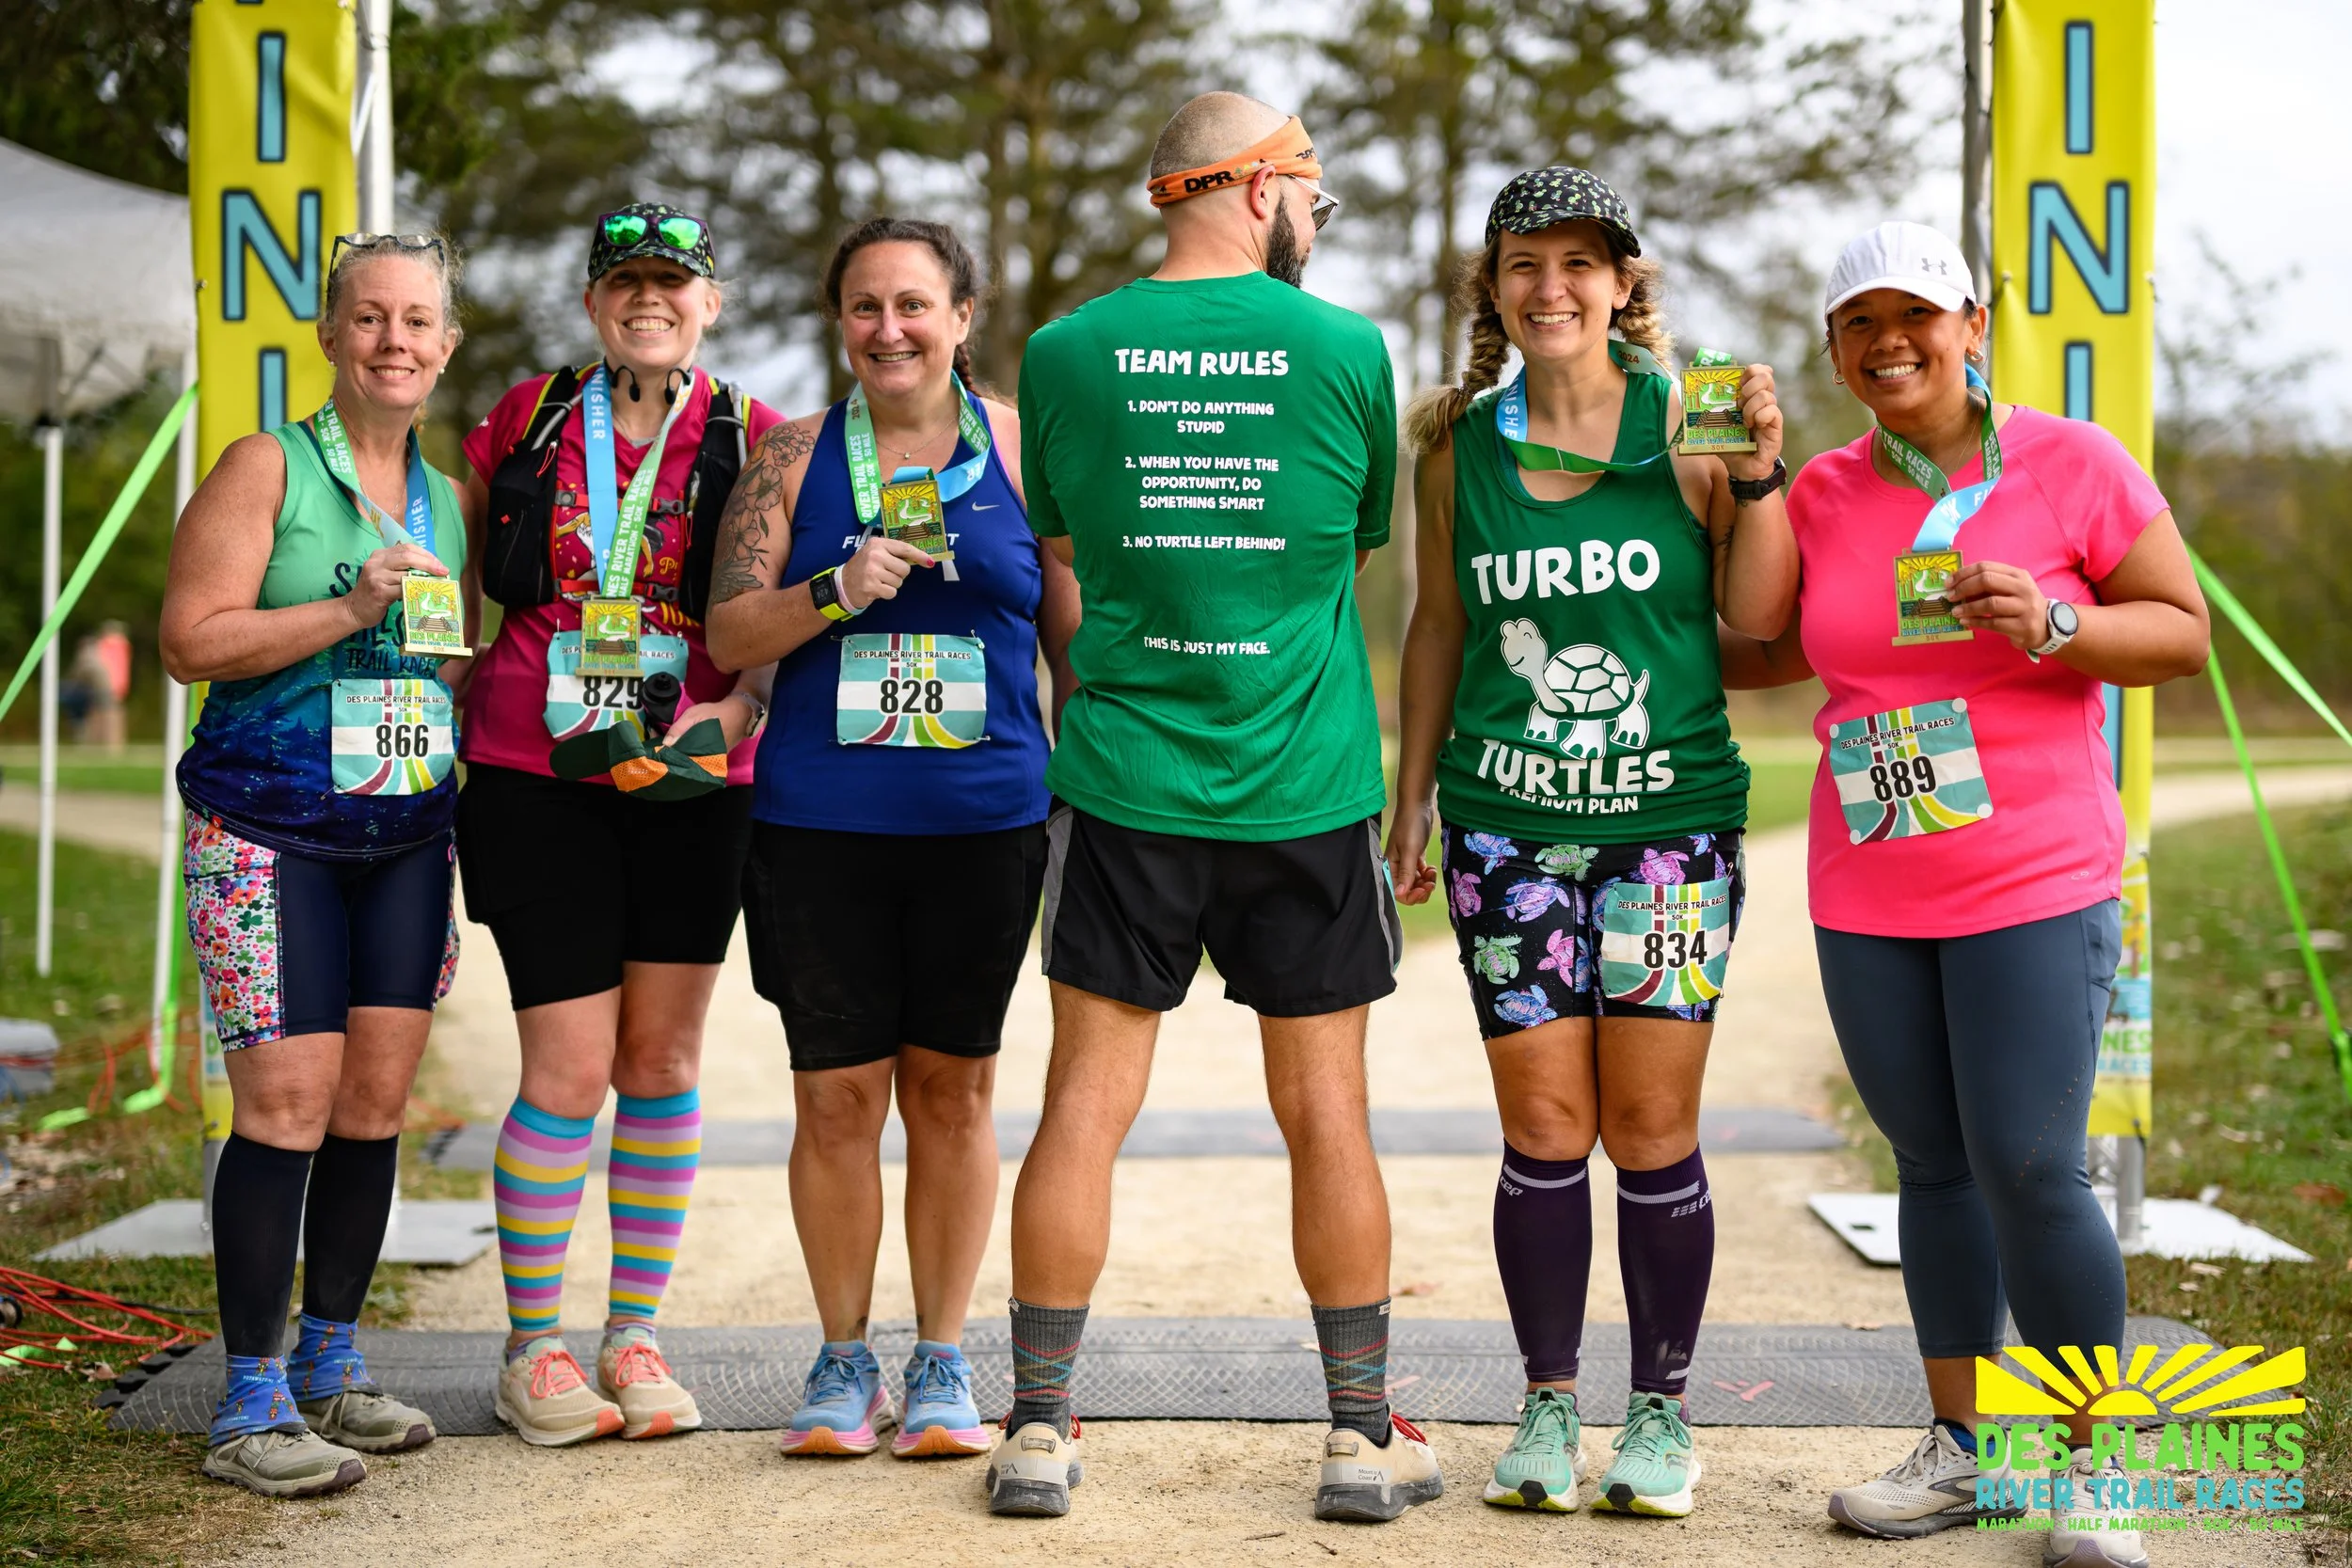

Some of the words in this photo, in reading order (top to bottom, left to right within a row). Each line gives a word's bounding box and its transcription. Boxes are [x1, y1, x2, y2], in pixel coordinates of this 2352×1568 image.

[1184, 171, 1234, 192] DPR
[1115, 349, 1192, 374] TEAM
[1200, 350, 1289, 376] RULES
[1128, 401, 1136, 413] 1.
[1139, 401, 1179, 414] DON'T
[1182, 402, 1201, 414] DO
[1204, 402, 1274, 416] ANYTHING
[1177, 421, 1225, 434] STUPID
[1687, 429, 1705, 438] DES
[1707, 427, 1746, 436] PLAINES
[326, 411, 342, 442] TRAIL
[335, 442, 352, 474] RACES
[849, 435, 864, 462] RACES
[1883, 431, 1904, 457] TRAIL
[1906, 450, 1932, 480] RACES
[854, 464, 867, 489] TRAIL
[1125, 457, 1136, 468] 2.
[1138, 457, 1180, 468] WHEN
[1184, 457, 1212, 468] YOU
[1215, 457, 1251, 470] HAVE
[1254, 459, 1279, 472] THE
[1908, 465, 1915, 476] 50
[1915, 472, 1929, 489] MILE
[627, 470, 646, 501] RACES
[1142, 477, 1240, 491] OPPORTUNITY,
[1242, 478, 1262, 490] DO
[858, 491, 873, 517] RIVER
[1139, 496, 1216, 510] SOMETHING
[1219, 497, 1264, 510] SMART
[619, 504, 635, 535] TRAIL
[612, 538, 628, 572] RIVER
[624, 531, 639, 574] MARATHON
[1123, 536, 1133, 547] 3.
[1135, 536, 1152, 548] NO
[1155, 536, 1201, 549] TURTLE
[1204, 537, 1232, 549] LEFT
[1235, 537, 1285, 550] BEHIND!
[1471, 539, 1660, 604] TURBO
[1902, 619, 1919, 628] DES
[1923, 615, 1960, 626] PLAINE
[1144, 637, 1168, 649] THIS
[1170, 640, 1181, 651] IS
[1184, 641, 1214, 655] JUST
[1216, 642, 1236, 655] MY
[1239, 641, 1270, 655] FACE.
[345, 648, 391, 672] TRAIL
[583, 676, 644, 709] 829
[881, 679, 943, 714] 828
[376, 724, 429, 758] 866
[1841, 739, 1851, 749] DES
[1852, 734, 1878, 747] PLAINES
[1880, 728, 1902, 740] RIVER
[1904, 722, 1927, 736] TRAIL
[1928, 718, 1955, 730] RACES
[1477, 738, 1675, 796] TURTLES
[1870, 756, 1936, 801] 889
[1588, 796, 1639, 815] PLAN
[1631, 902, 1663, 911] PLAINES
[1692, 900, 1709, 909] TRAIL
[1711, 895, 1725, 905] RACES
[1645, 931, 1707, 968] 834
